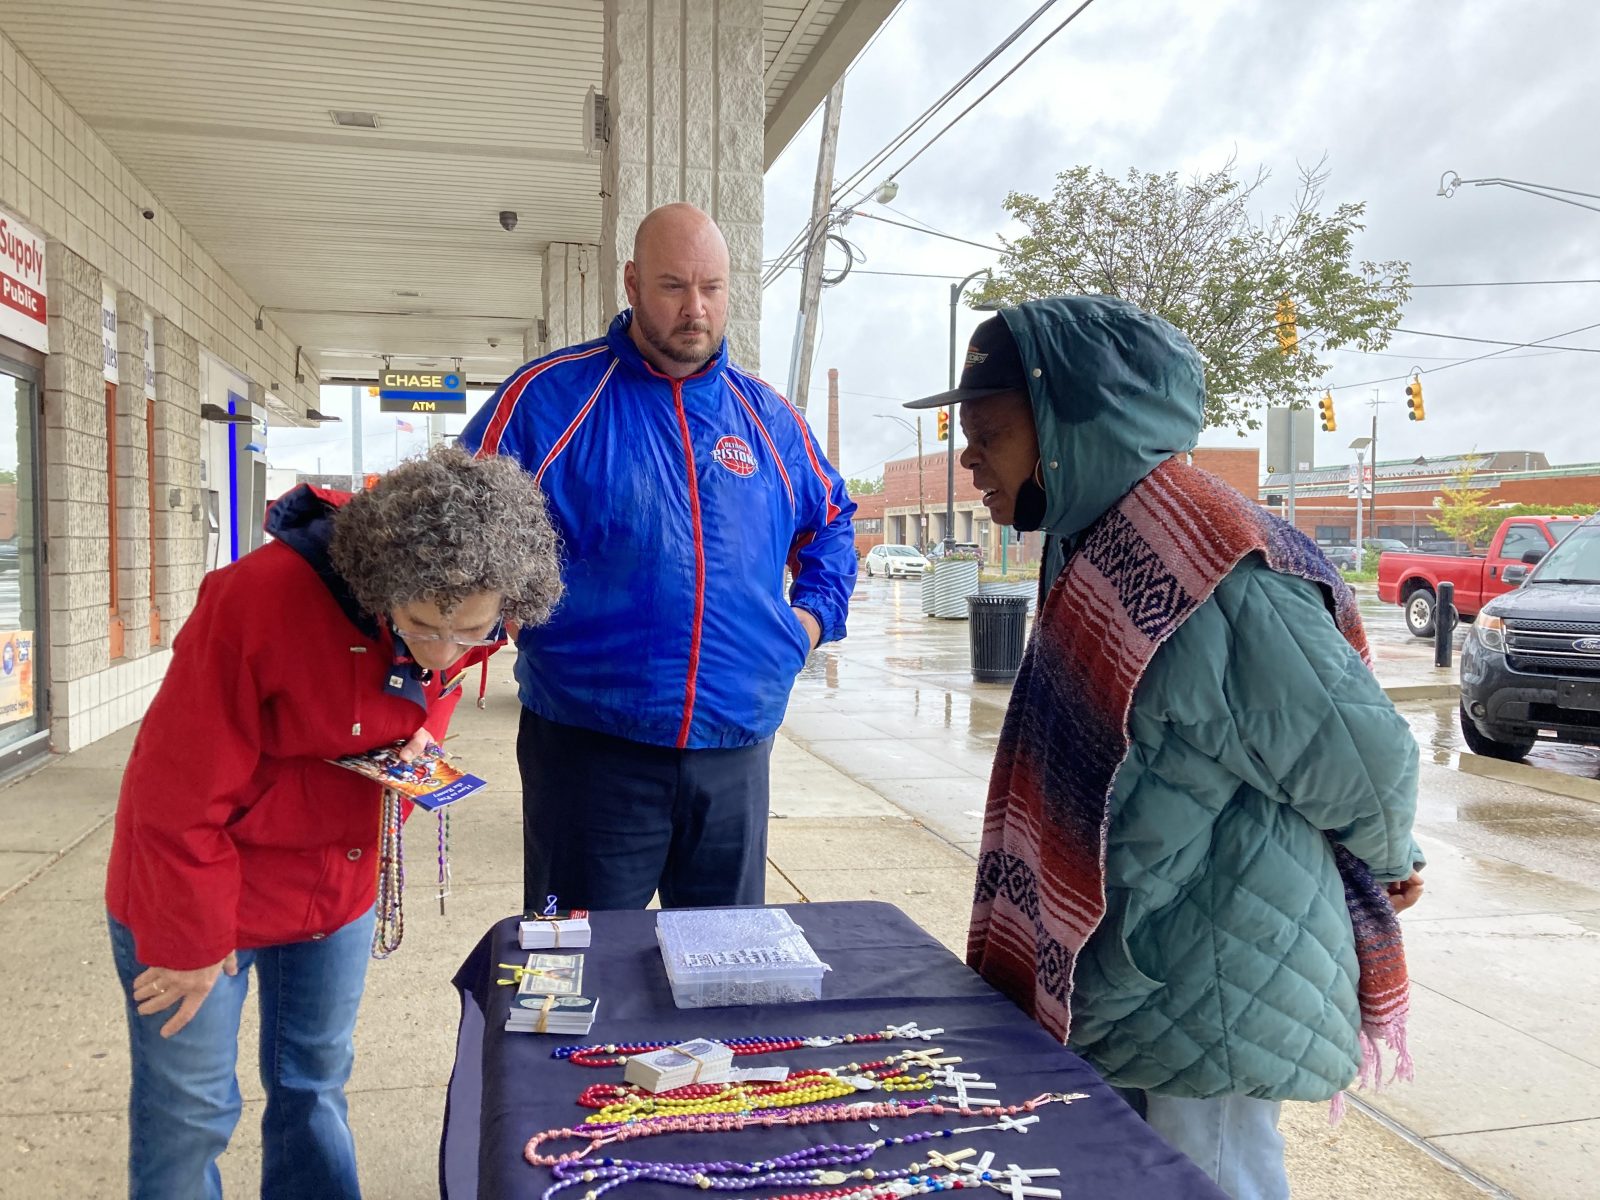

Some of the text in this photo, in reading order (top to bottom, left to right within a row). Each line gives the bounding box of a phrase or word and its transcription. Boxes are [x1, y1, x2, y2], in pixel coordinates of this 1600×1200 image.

[0, 218, 43, 286] Supply
[3, 277, 38, 312] Public
[385, 374, 442, 388] CHASE
[412, 401, 436, 411] ATM
[709, 448, 758, 467] PISTON
